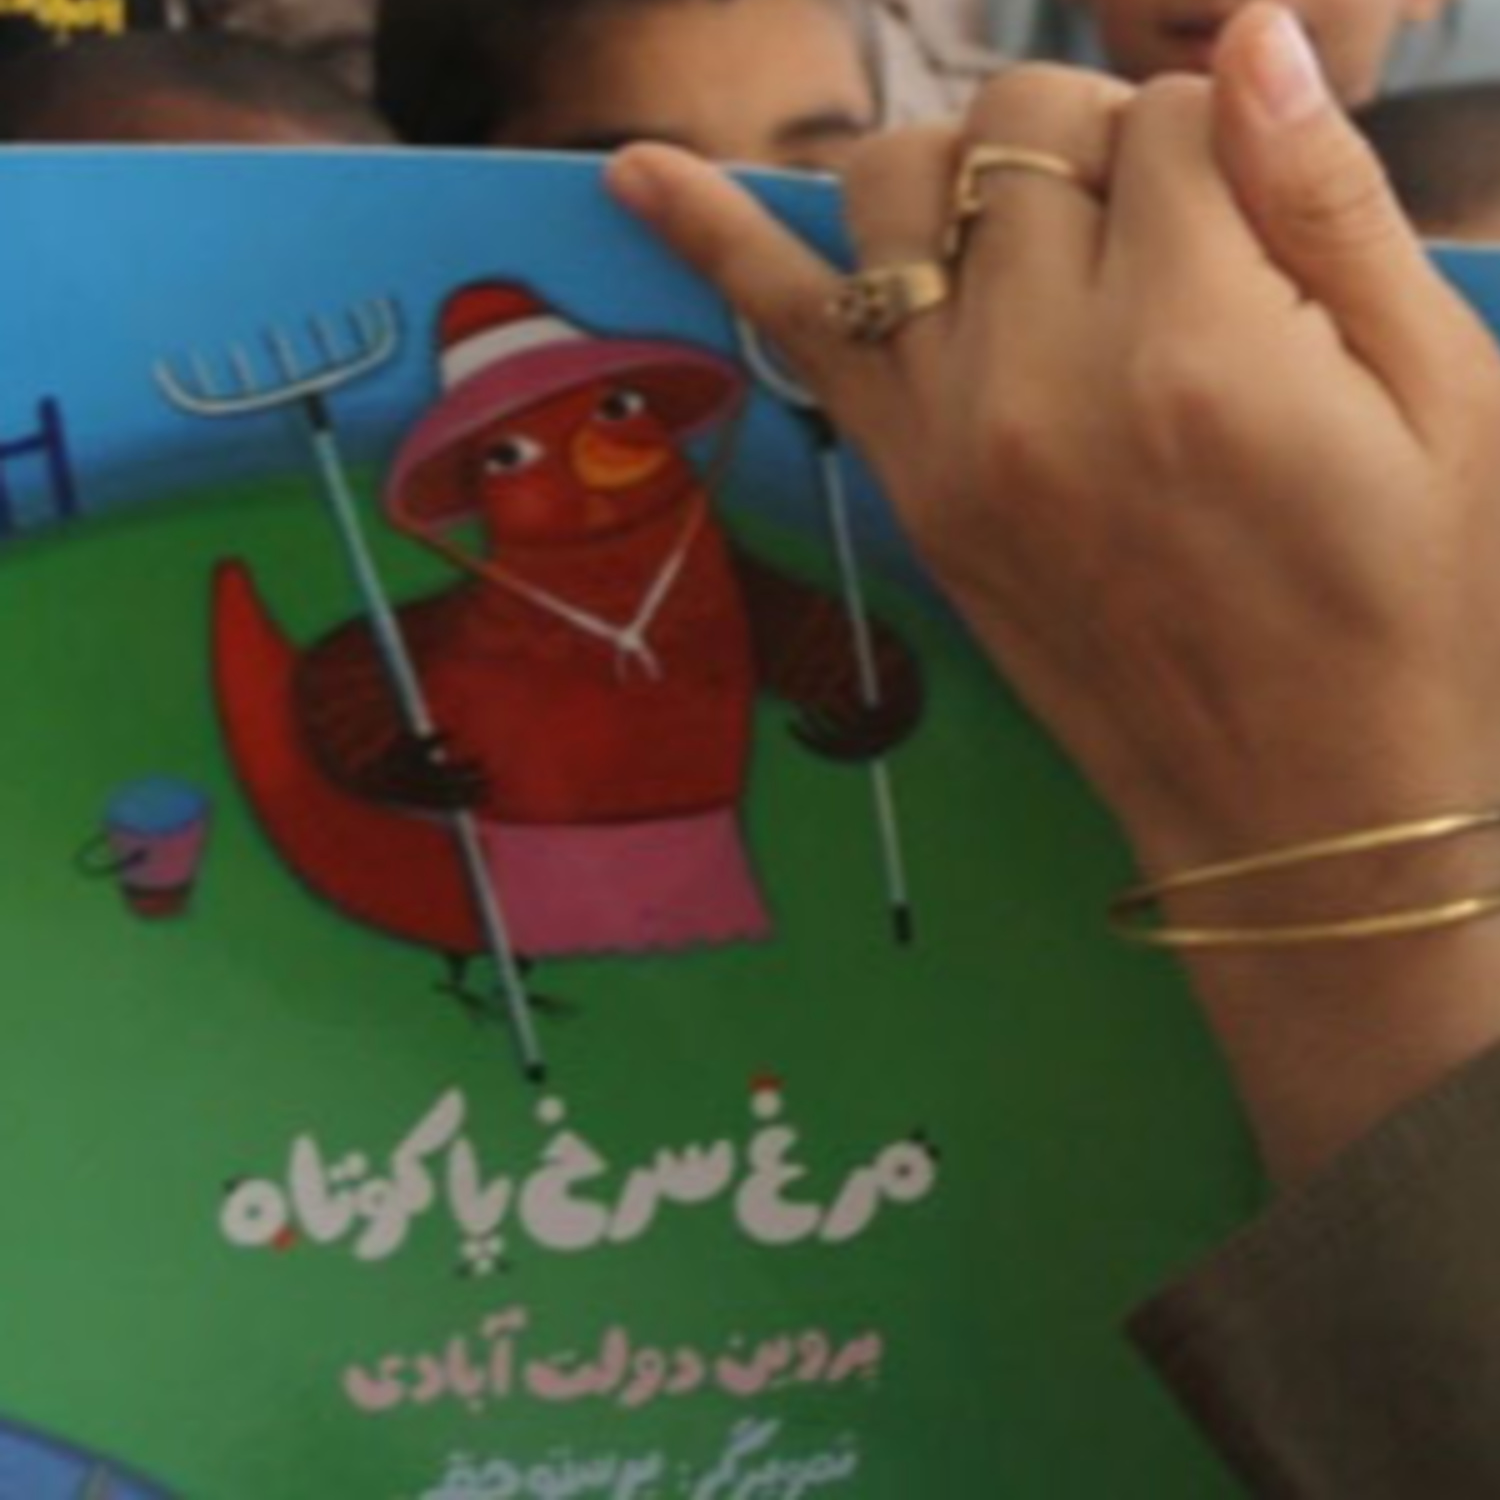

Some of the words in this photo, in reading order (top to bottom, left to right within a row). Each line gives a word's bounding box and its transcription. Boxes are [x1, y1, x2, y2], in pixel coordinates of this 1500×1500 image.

[518, 1094, 736, 1251] سرخ
[735, 1088, 938, 1244] مرغ
[716, 1328, 886, 1394] پروین
